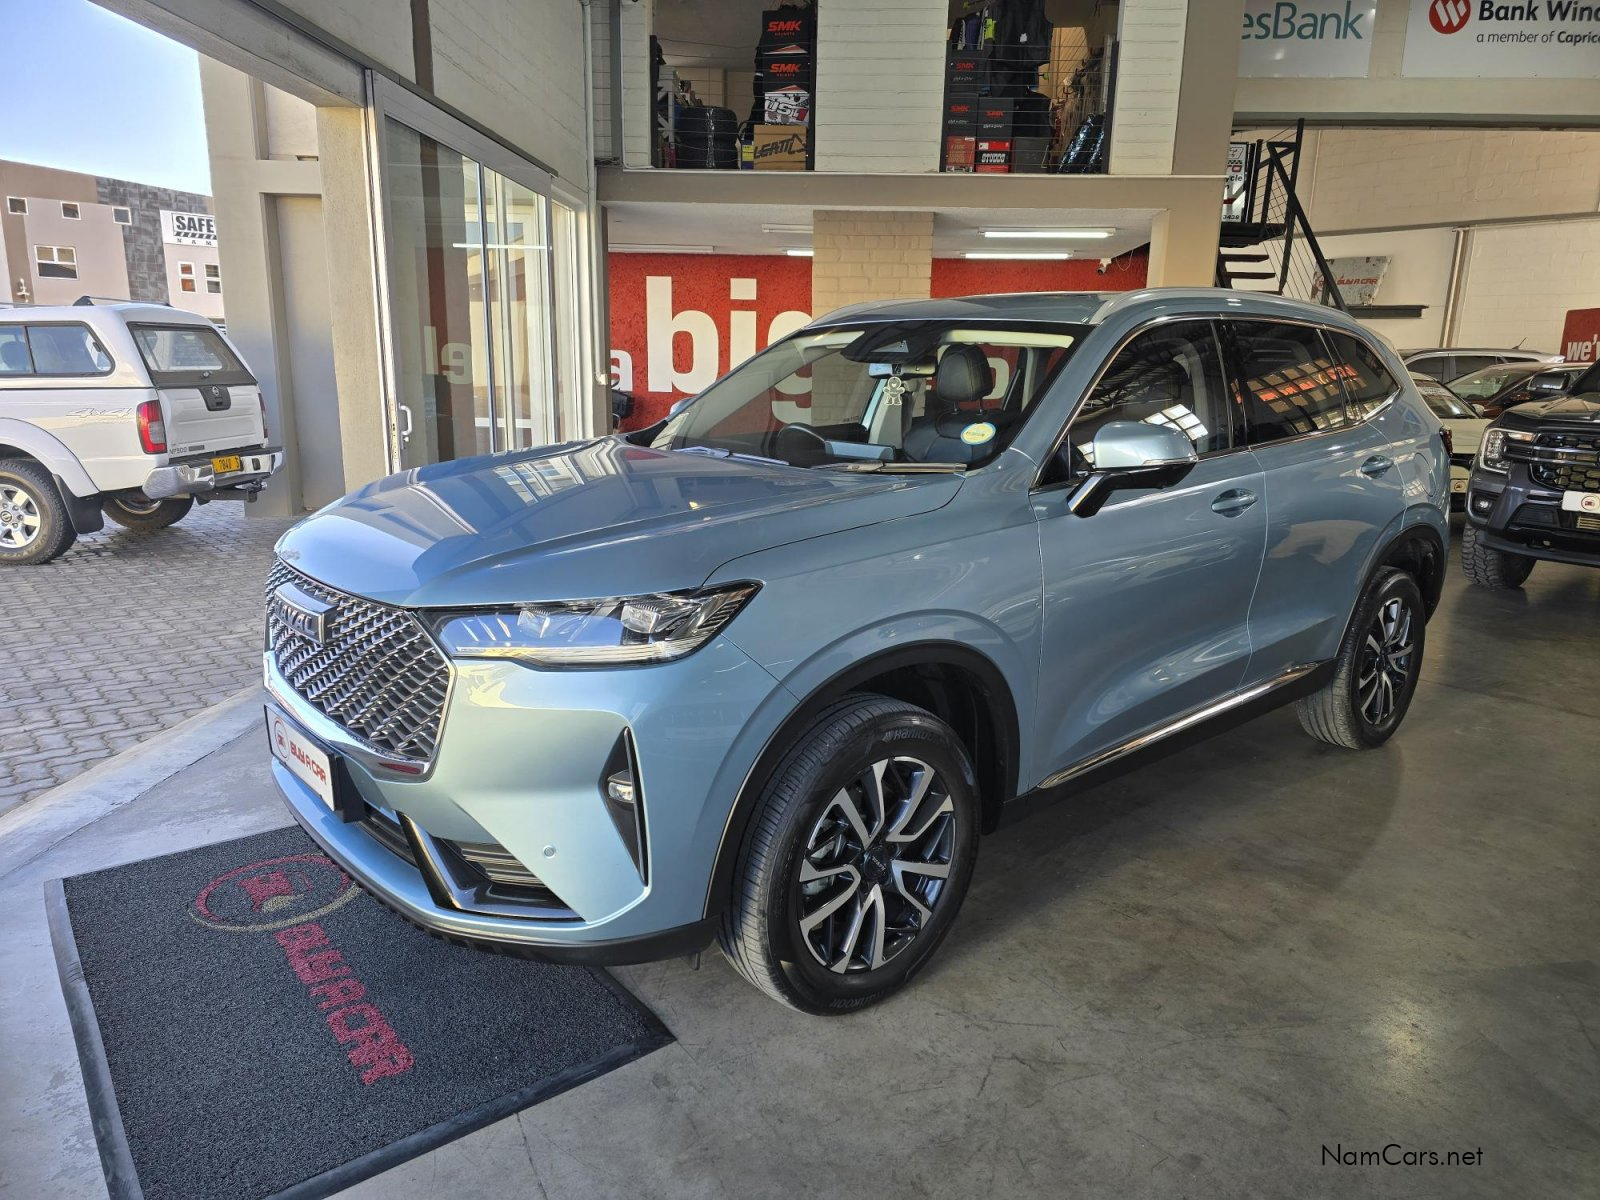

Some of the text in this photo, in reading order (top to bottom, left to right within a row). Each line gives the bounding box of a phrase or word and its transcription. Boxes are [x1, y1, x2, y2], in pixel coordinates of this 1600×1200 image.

[1478, 0, 1539, 21] Bank
[768, 20, 802, 31] SMK
[1476, 33, 1484, 43] a
[1487, 31, 1538, 43] member
[1541, 31, 1555, 43] of
[770, 63, 802, 73] SMK
[175, 215, 215, 233] SAFE
[274, 600, 316, 635] HAVAL
[290, 741, 306, 765] BUY
[311, 760, 327, 786] CAR
[272, 923, 352, 984] BUY
[326, 1002, 415, 1085] CAR
